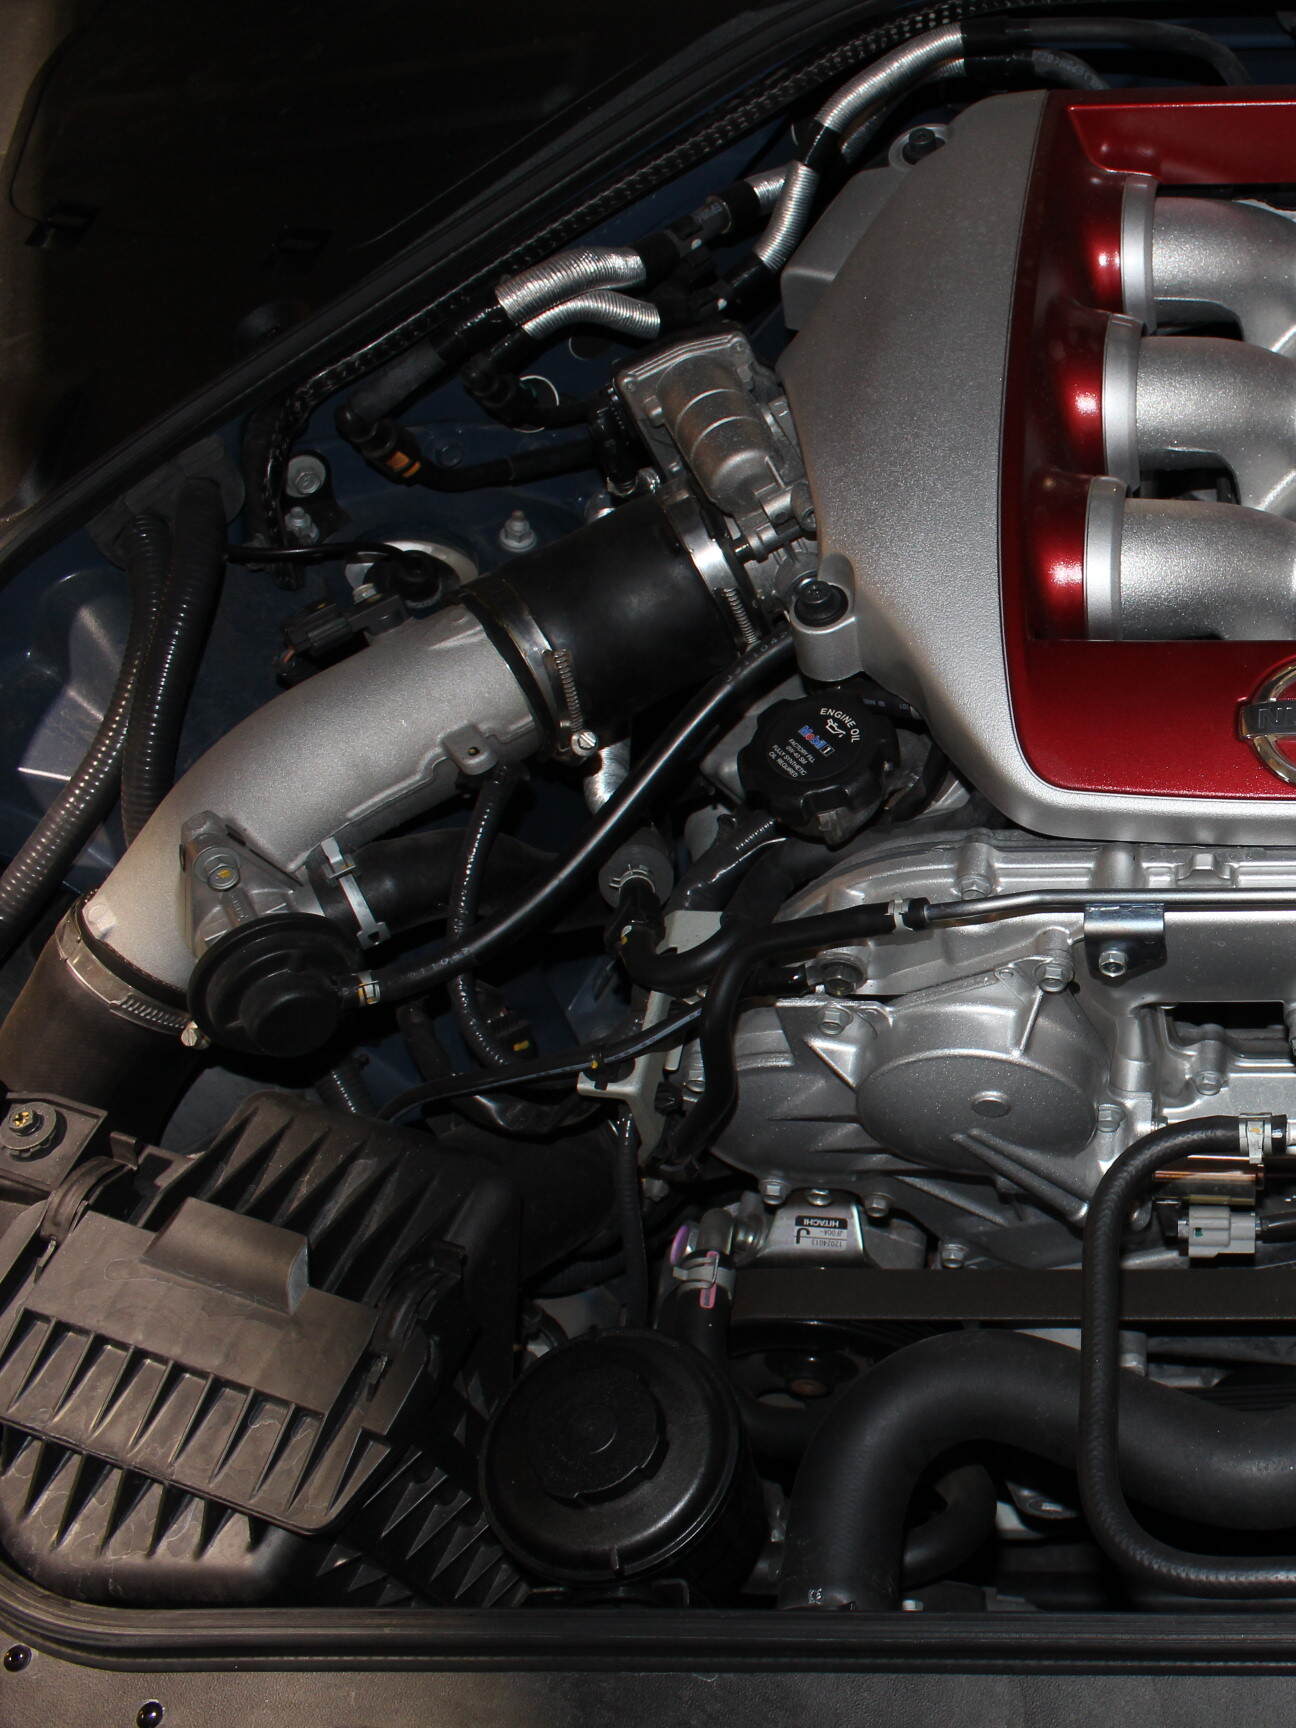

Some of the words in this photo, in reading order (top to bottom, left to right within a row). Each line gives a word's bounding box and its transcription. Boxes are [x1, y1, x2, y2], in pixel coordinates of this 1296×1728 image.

[798, 724, 827, 750] Mobil
[820, 707, 856, 728] ENGINE
[850, 728, 860, 743] OIL
[772, 744, 786, 756] FULLY
[784, 755, 808, 776] SYNTHETIC
[789, 738, 808, 755] FACTORY
[806, 754, 815, 763] FILL
[776, 758, 798, 778] REQUIRED
[803, 1218, 839, 1228] HITACHI
[796, 1228, 810, 1244] J
